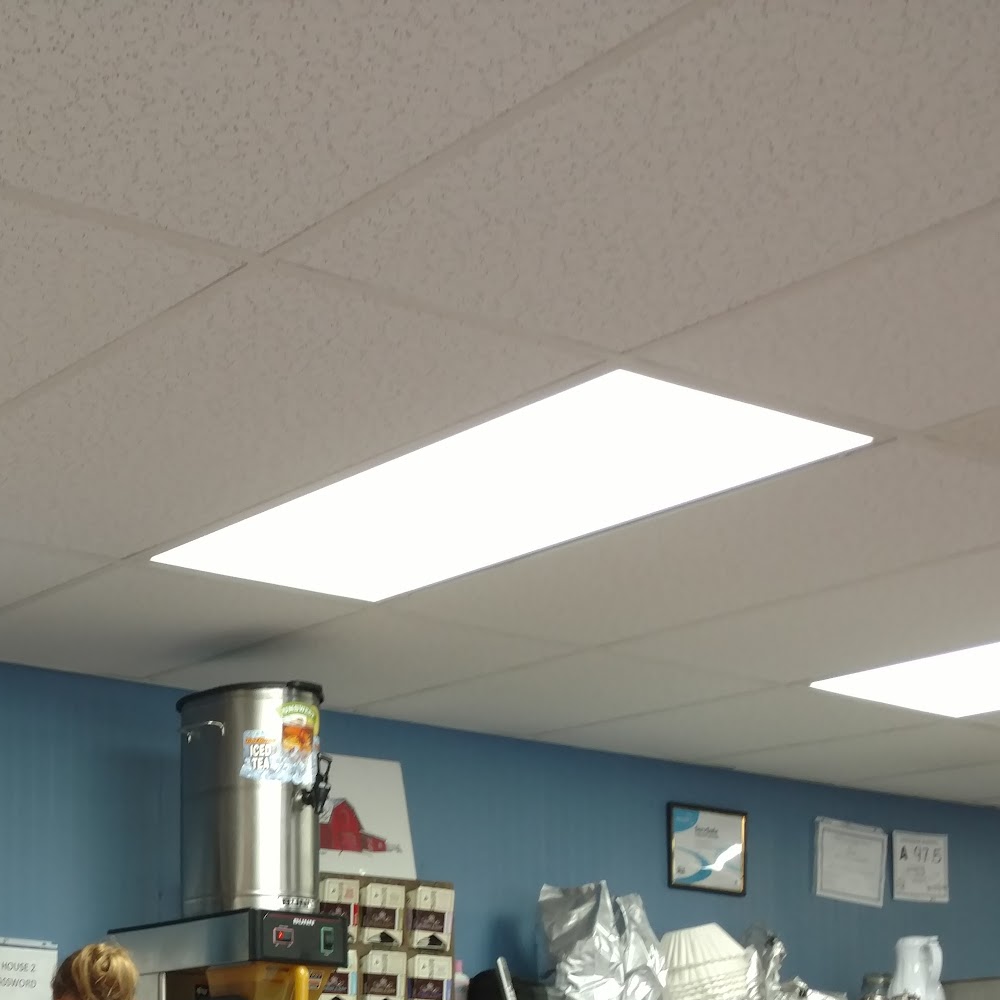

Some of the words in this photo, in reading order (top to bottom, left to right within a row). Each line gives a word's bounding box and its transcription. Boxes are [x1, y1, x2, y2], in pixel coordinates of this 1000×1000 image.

[250, 744, 271, 757] ICED
[251, 757, 270, 770] TEA
[1, 961, 29, 972] HOUSE
[30, 964, 36, 972] 2
